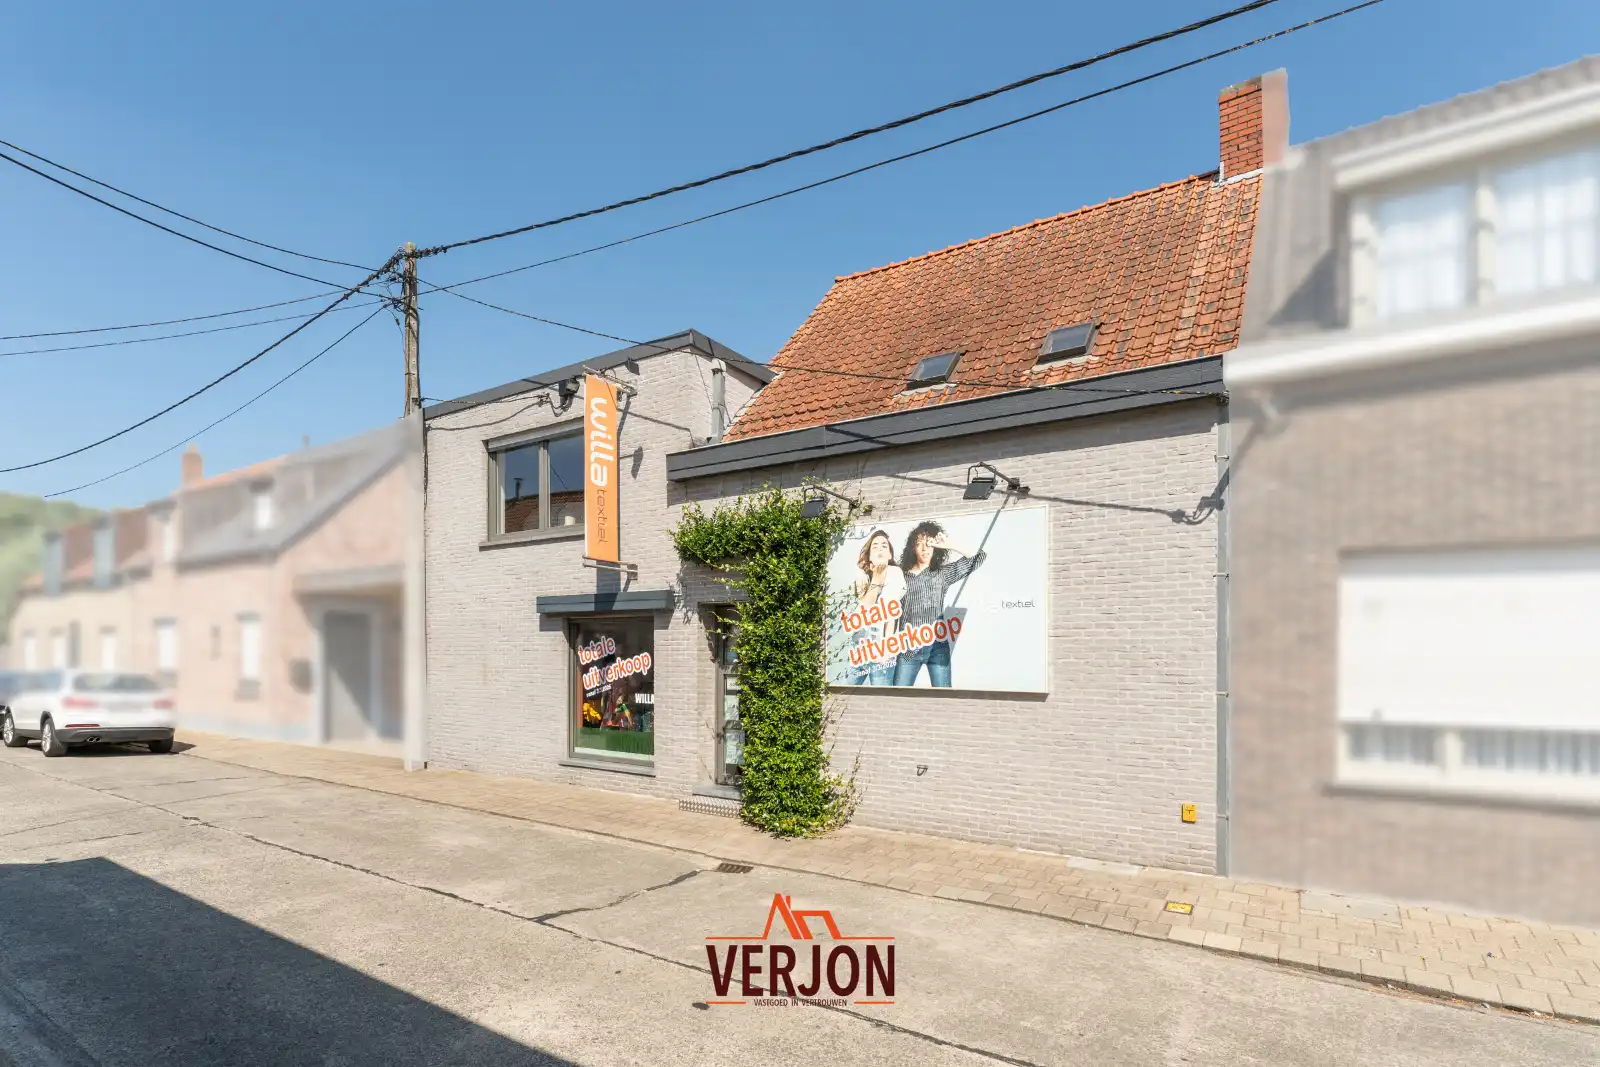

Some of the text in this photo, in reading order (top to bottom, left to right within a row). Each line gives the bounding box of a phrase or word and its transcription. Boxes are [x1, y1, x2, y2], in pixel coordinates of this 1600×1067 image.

[590, 397, 615, 545] willa textiel
[841, 597, 902, 635] totale
[1001, 598, 1036, 609] textiel
[578, 636, 616, 665] totale
[848, 616, 963, 667] uitverkoop
[582, 651, 651, 690] uitverkoop
